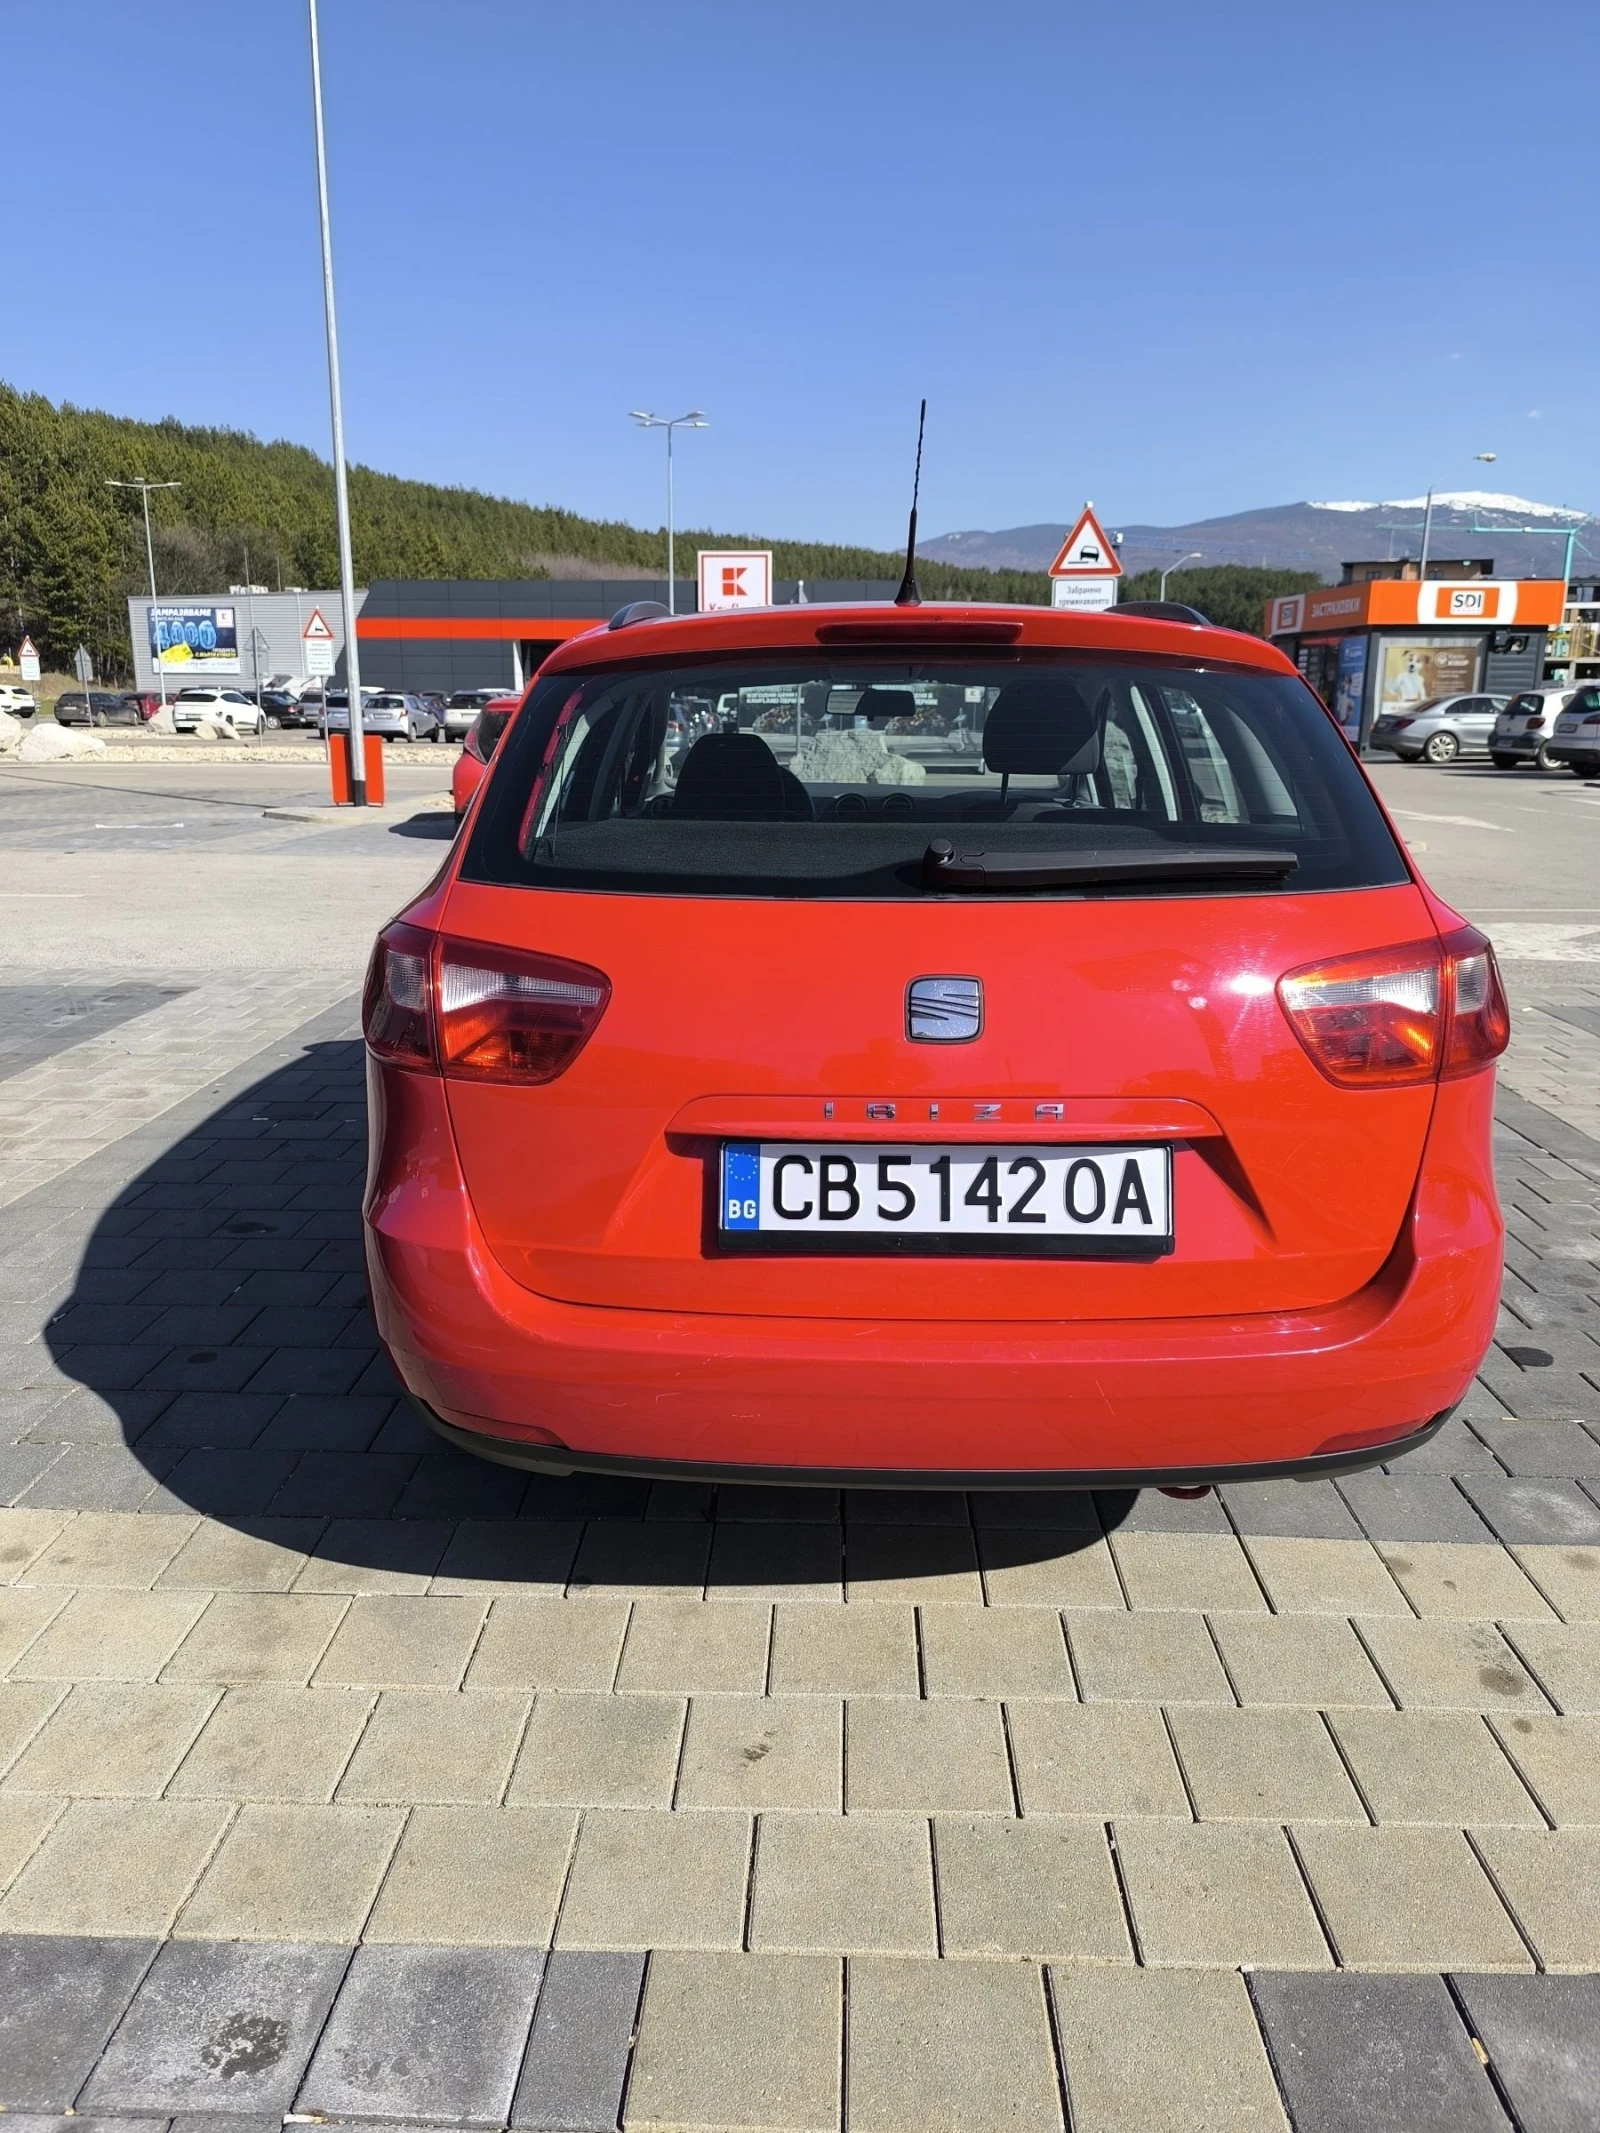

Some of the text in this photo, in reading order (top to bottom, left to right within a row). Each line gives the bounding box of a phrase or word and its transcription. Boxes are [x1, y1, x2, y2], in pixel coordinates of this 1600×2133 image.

[1453, 594, 1482, 608] SDI
[153, 620, 217, 650] 4000
[824, 1101, 1065, 1121] IBIZA
[728, 1199, 757, 1220] BG
